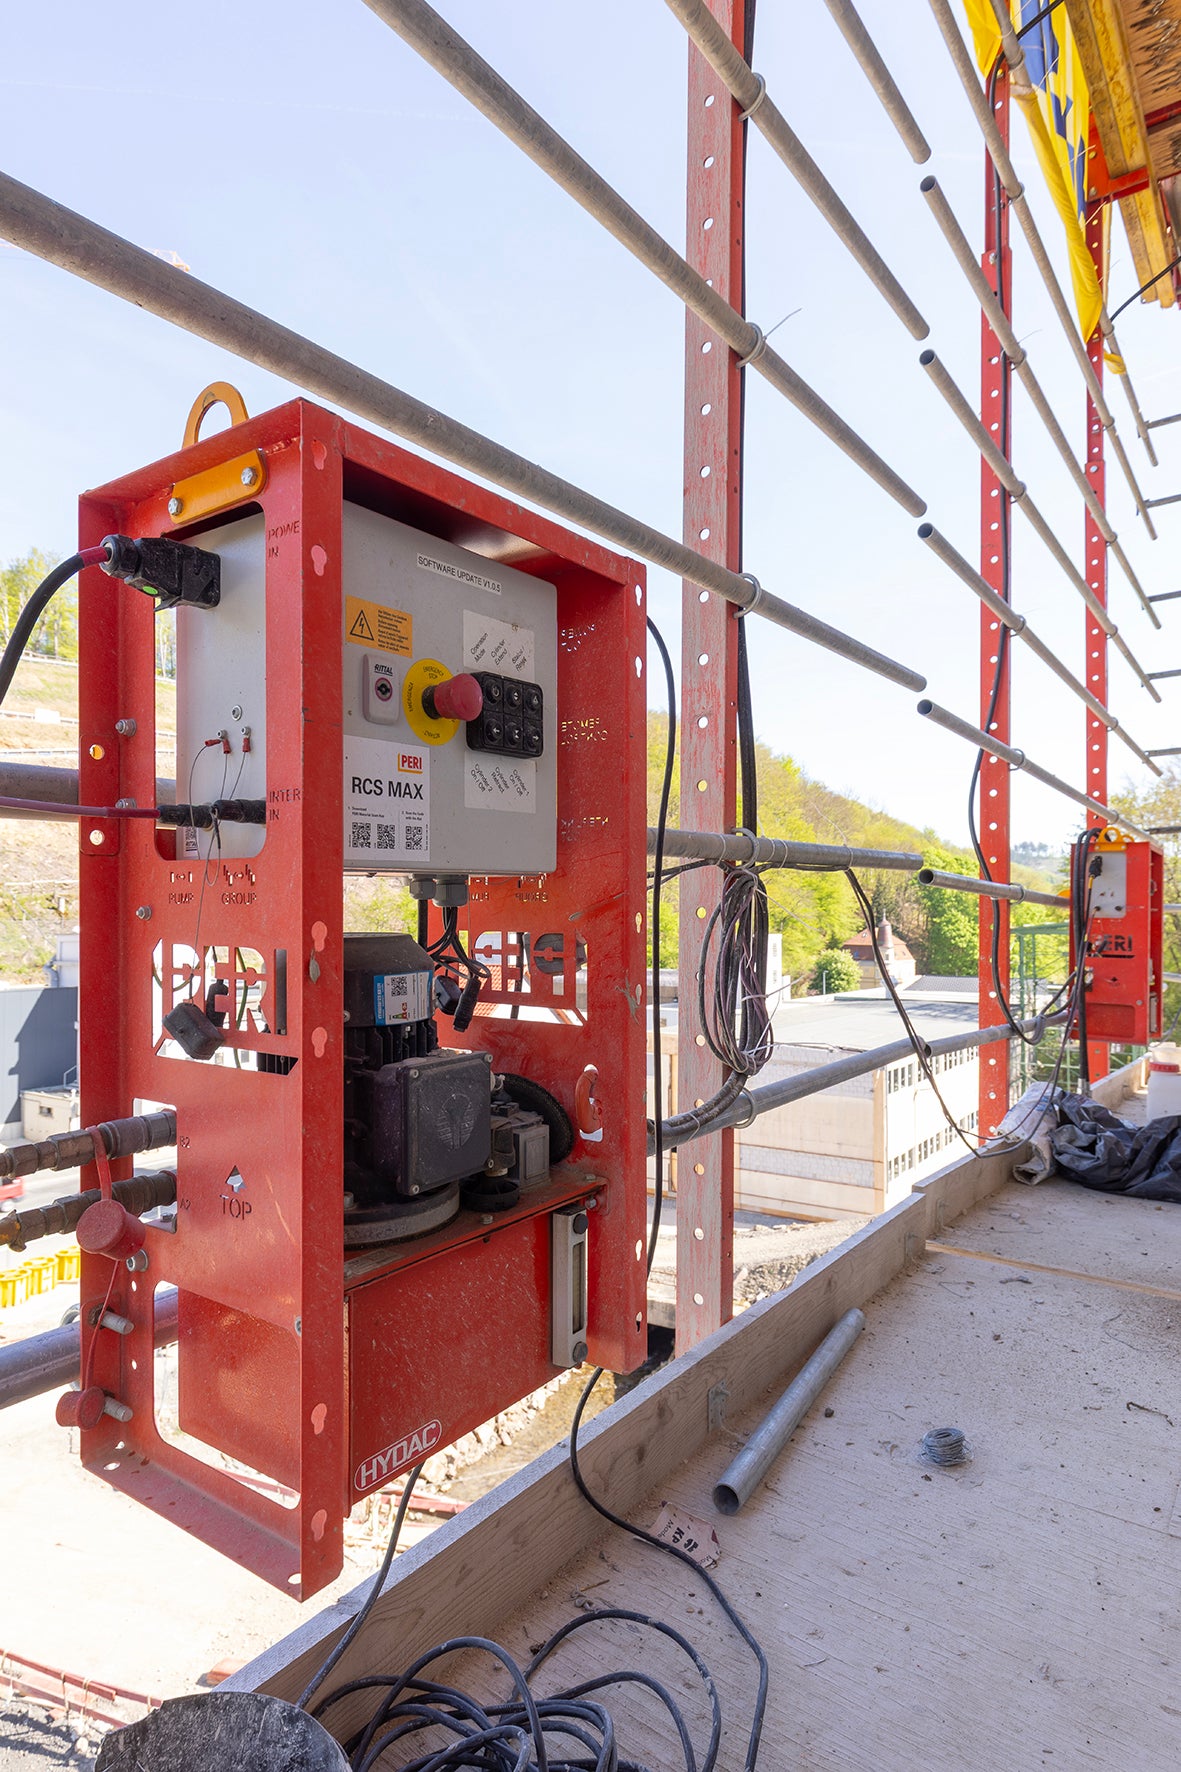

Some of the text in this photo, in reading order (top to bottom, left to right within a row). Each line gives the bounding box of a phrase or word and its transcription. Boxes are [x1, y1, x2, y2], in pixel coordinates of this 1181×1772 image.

[268, 546, 278, 558] IN
[418, 556, 500, 592] SOFTWARE UPDATE V1.0.5
[374, 664, 393, 674] RITTAL
[402, 754, 422, 770] PERI
[352, 776, 424, 800] RCS MAX
[270, 809, 280, 821] IN
[168, 892, 194, 904] PUMP
[222, 892, 256, 904] GROUP
[1092, 933, 1133, 952] ERI
[172, 943, 288, 1036] PERI
[180, 1136, 190, 1148] B2
[180, 1199, 191, 1210] A2
[220, 1194, 252, 1220] TOP
[361, 1422, 436, 1488] HYDAC
[672, 1527, 684, 1544] KP
